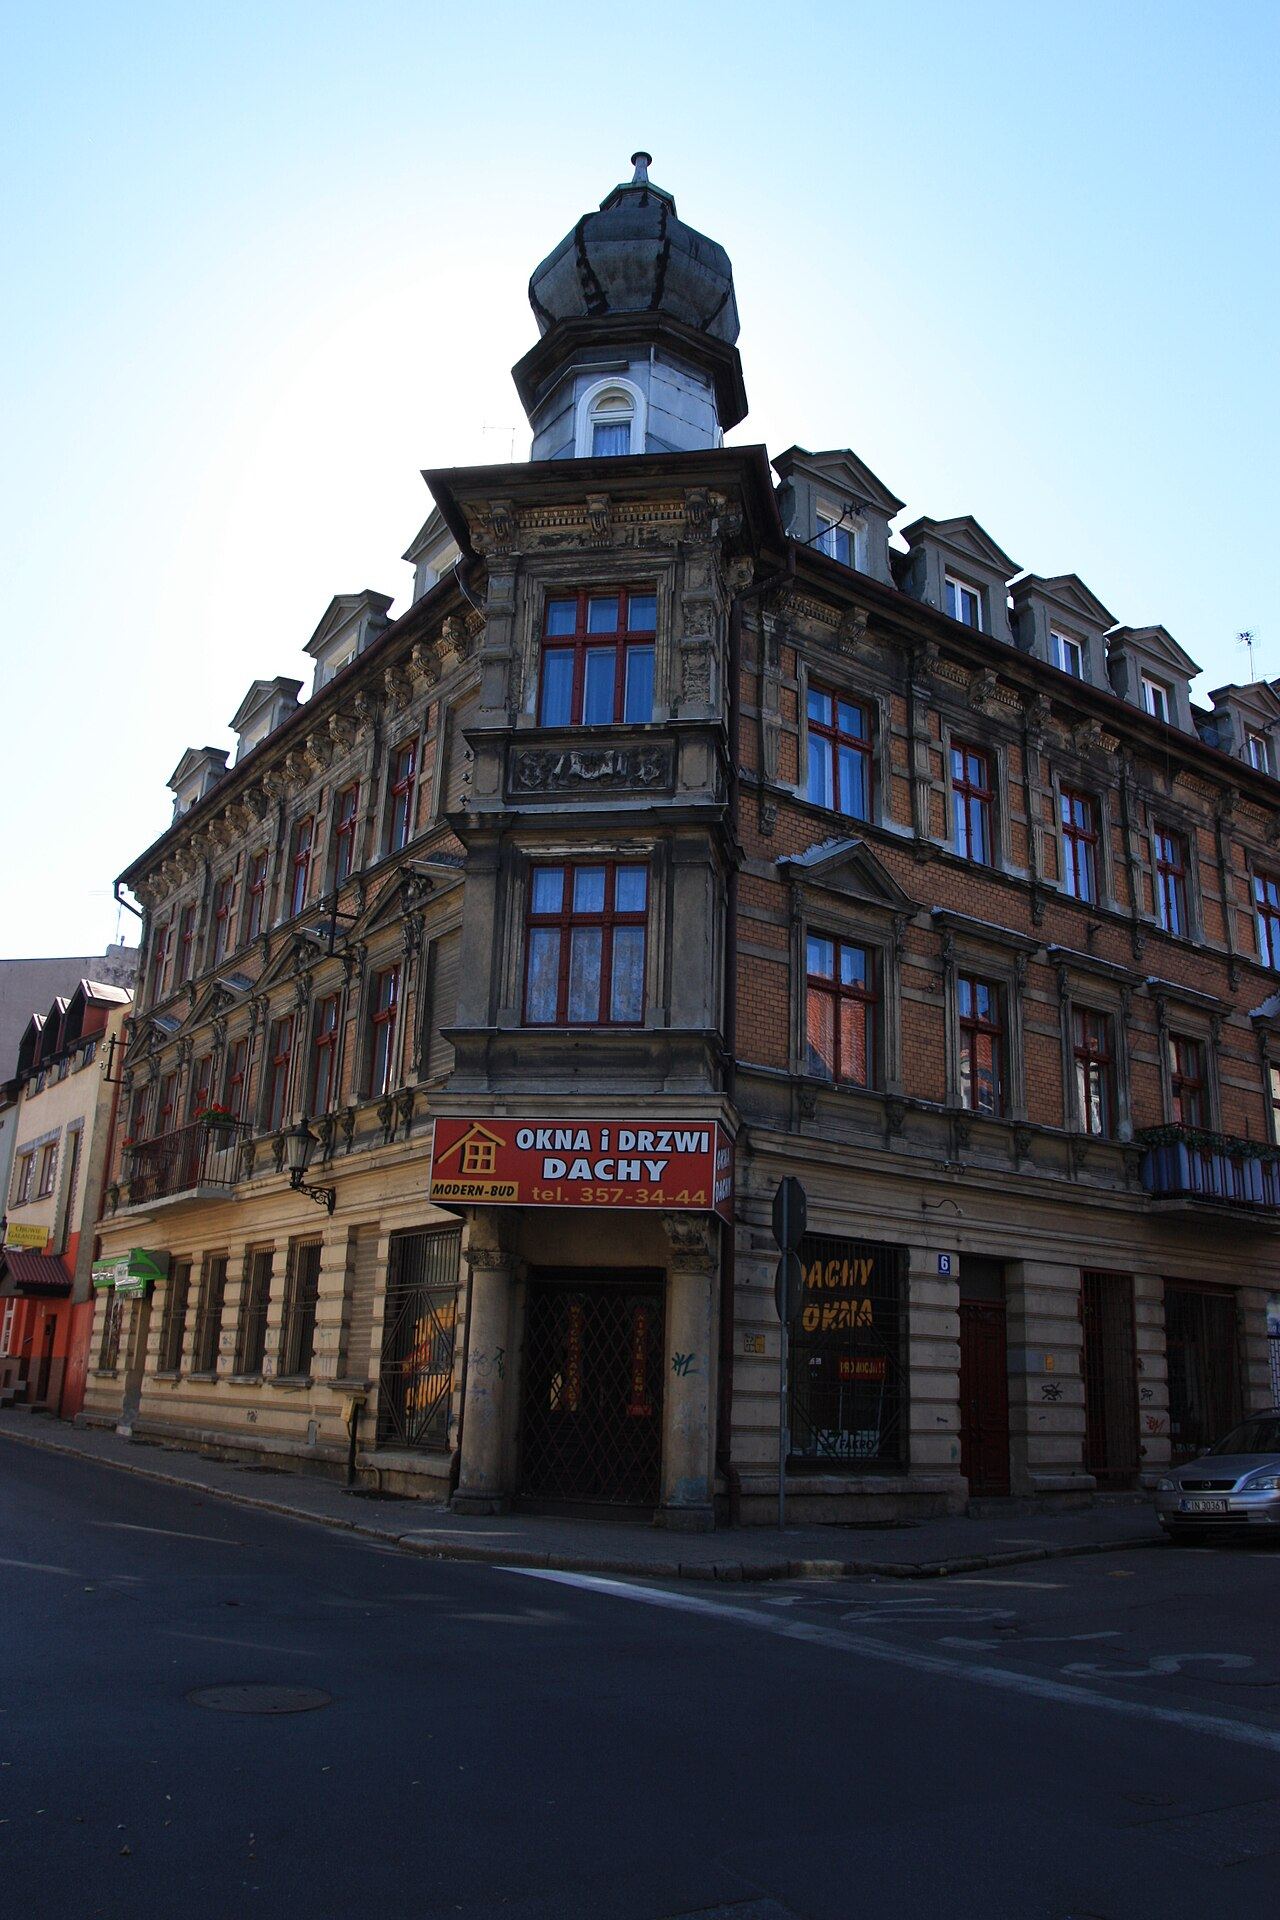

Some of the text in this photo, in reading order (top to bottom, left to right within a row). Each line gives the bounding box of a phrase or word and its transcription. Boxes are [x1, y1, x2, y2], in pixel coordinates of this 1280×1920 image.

[516, 1128, 709, 1153] OKNA i DRZWI
[543, 1158, 668, 1181] DACHY
[432, 1182, 515, 1197] MODERN-BUD
[532, 1187, 707, 1205] tel. 357-34-44
[940, 1255, 949, 1270] 6
[802, 1298, 873, 1332] OKNA
